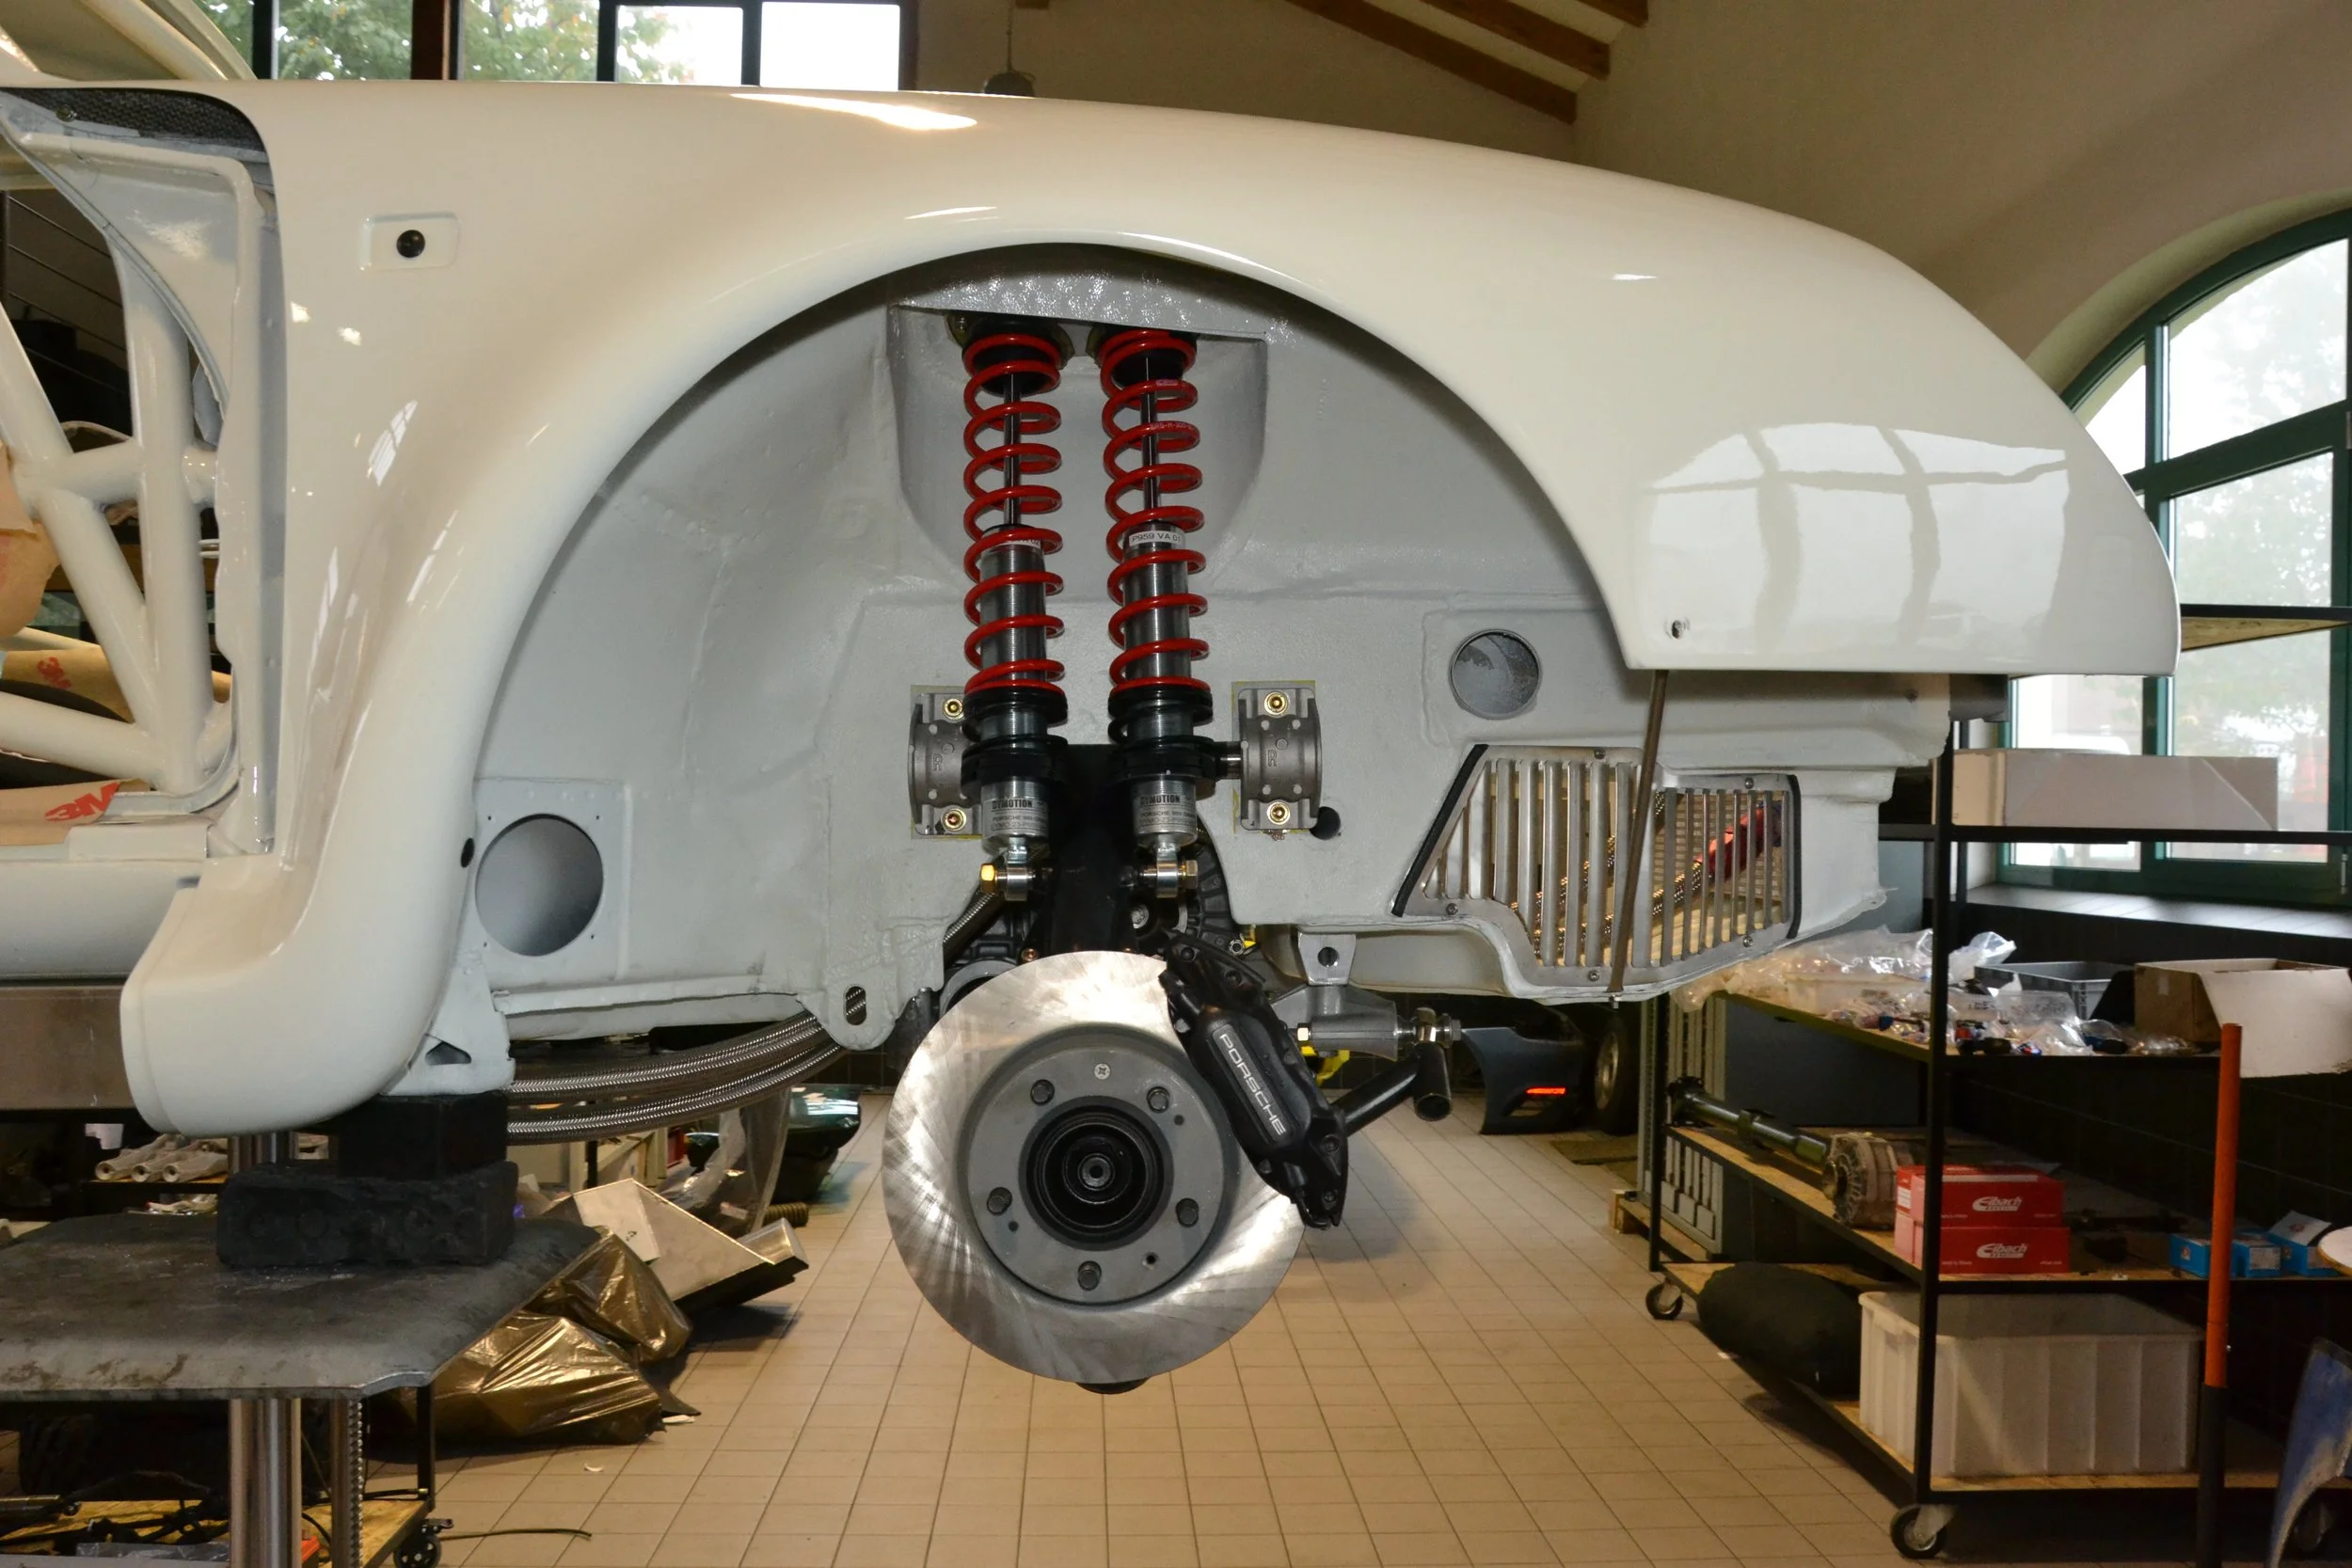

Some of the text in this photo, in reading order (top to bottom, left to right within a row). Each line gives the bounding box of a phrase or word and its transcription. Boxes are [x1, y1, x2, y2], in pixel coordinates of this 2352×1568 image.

[1132, 533, 1155, 543] P959
[932, 753, 943, 771] R
[1267, 750, 1278, 768] R
[45, 782, 119, 821] 3M
[1219, 1034, 1286, 1135] PORSCHE
